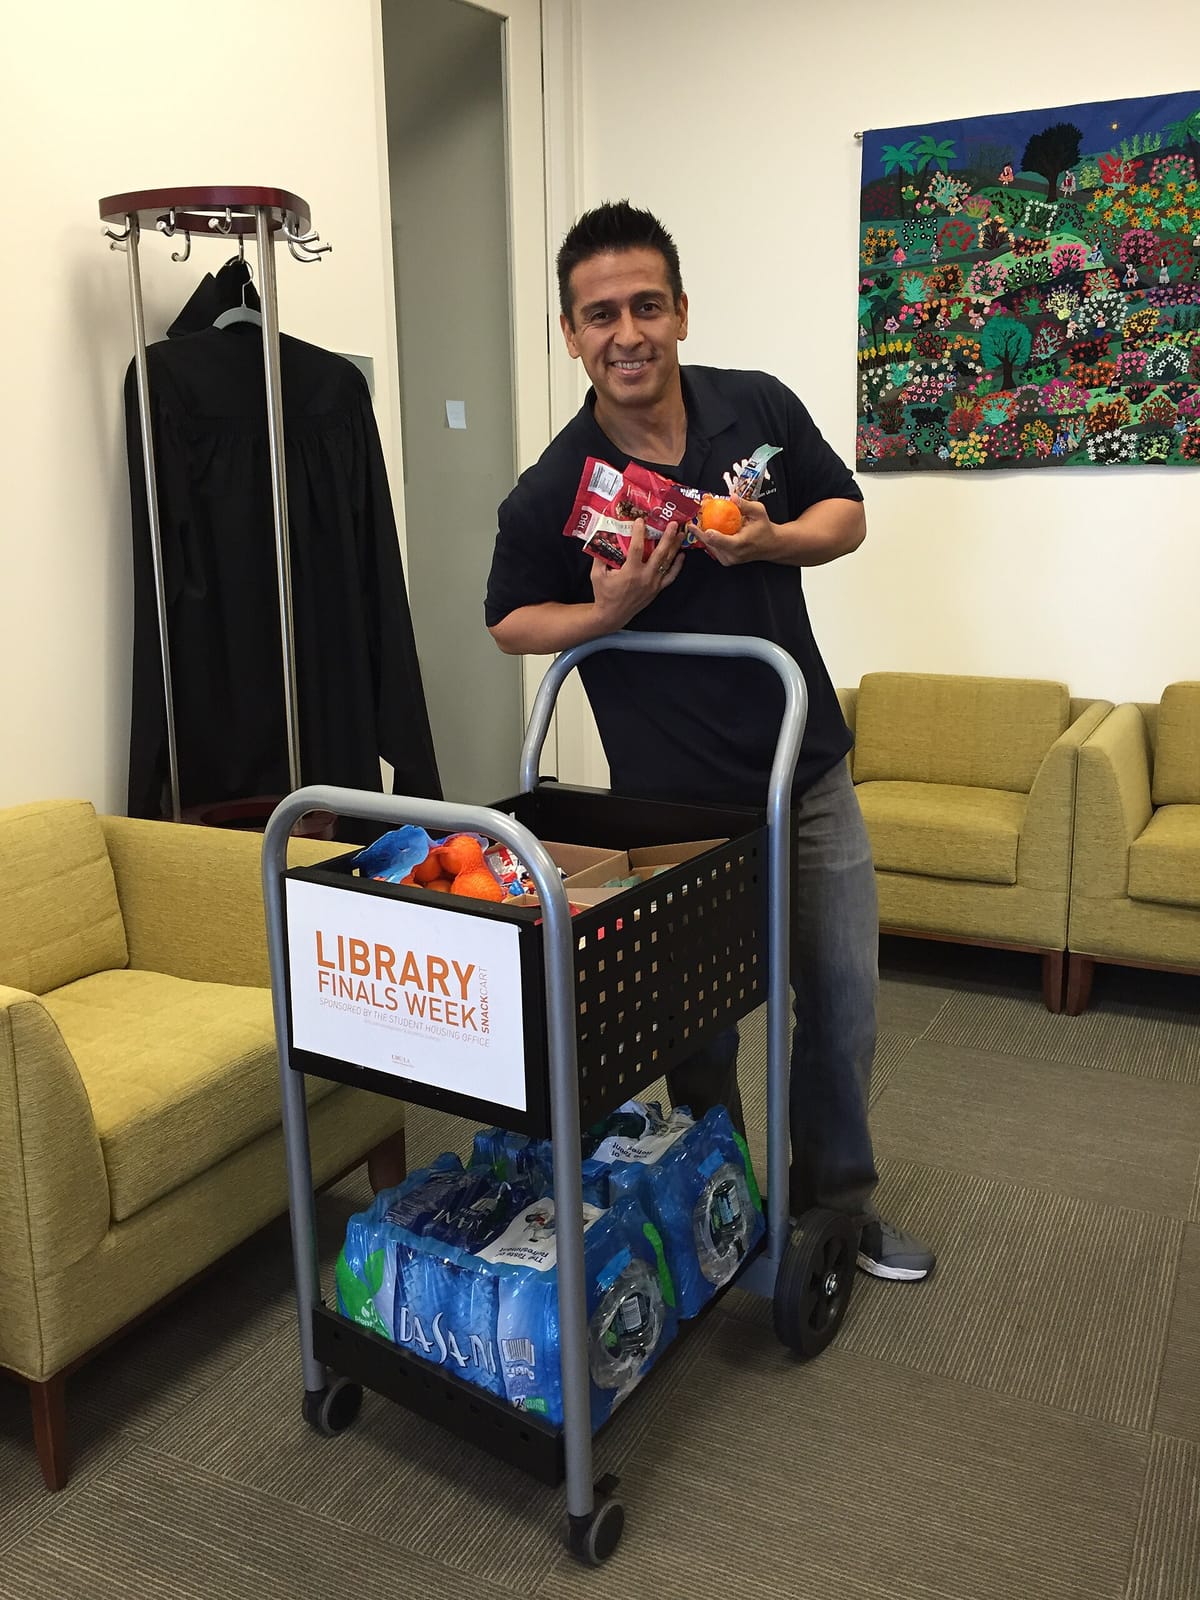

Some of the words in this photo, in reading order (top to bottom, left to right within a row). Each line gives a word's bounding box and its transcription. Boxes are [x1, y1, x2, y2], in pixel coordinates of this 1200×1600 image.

[578, 513, 588, 530] 180
[659, 501, 677, 521] 180
[316, 930, 476, 1001] LIBRARY
[318, 970, 398, 1011] FINALS
[404, 991, 478, 1032] WEEK
[319, 997, 363, 1016] SPONSORED
[363, 1007, 373, 1018] BY
[373, 1010, 388, 1022] THE
[388, 1013, 424, 1031] STUDENT
[425, 1024, 460, 1041] HOUSING
[461, 1033, 490, 1048] OFFICE
[506, 1252, 527, 1260] Taste
[528, 1256, 544, 1264] The
[399, 1306, 498, 1375] DASANI
